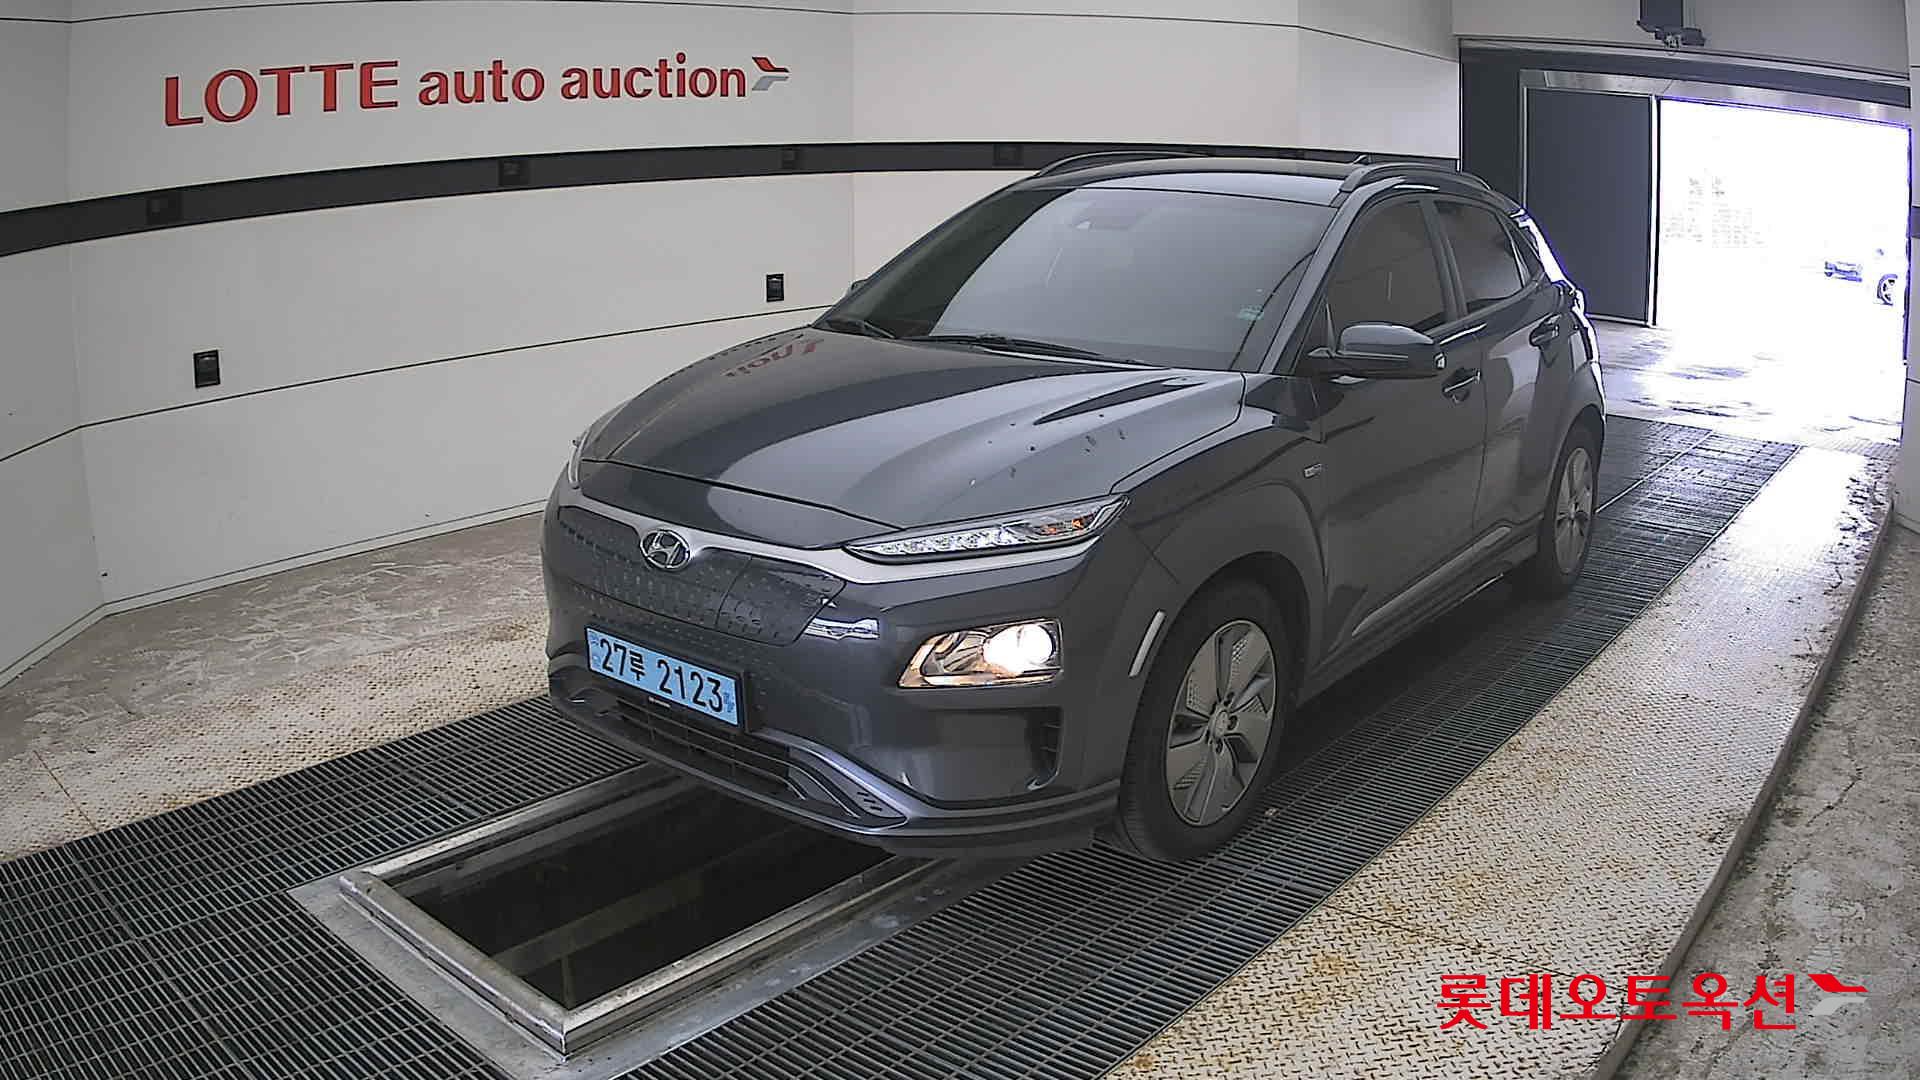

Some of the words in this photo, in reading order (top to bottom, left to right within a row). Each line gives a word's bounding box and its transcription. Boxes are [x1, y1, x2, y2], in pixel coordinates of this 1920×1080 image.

[164, 60, 399, 127] LOTTE
[418, 59, 545, 106] auto
[560, 52, 747, 101] auction
[600, 638, 647, 681] 27루
[656, 659, 723, 713] 2123
